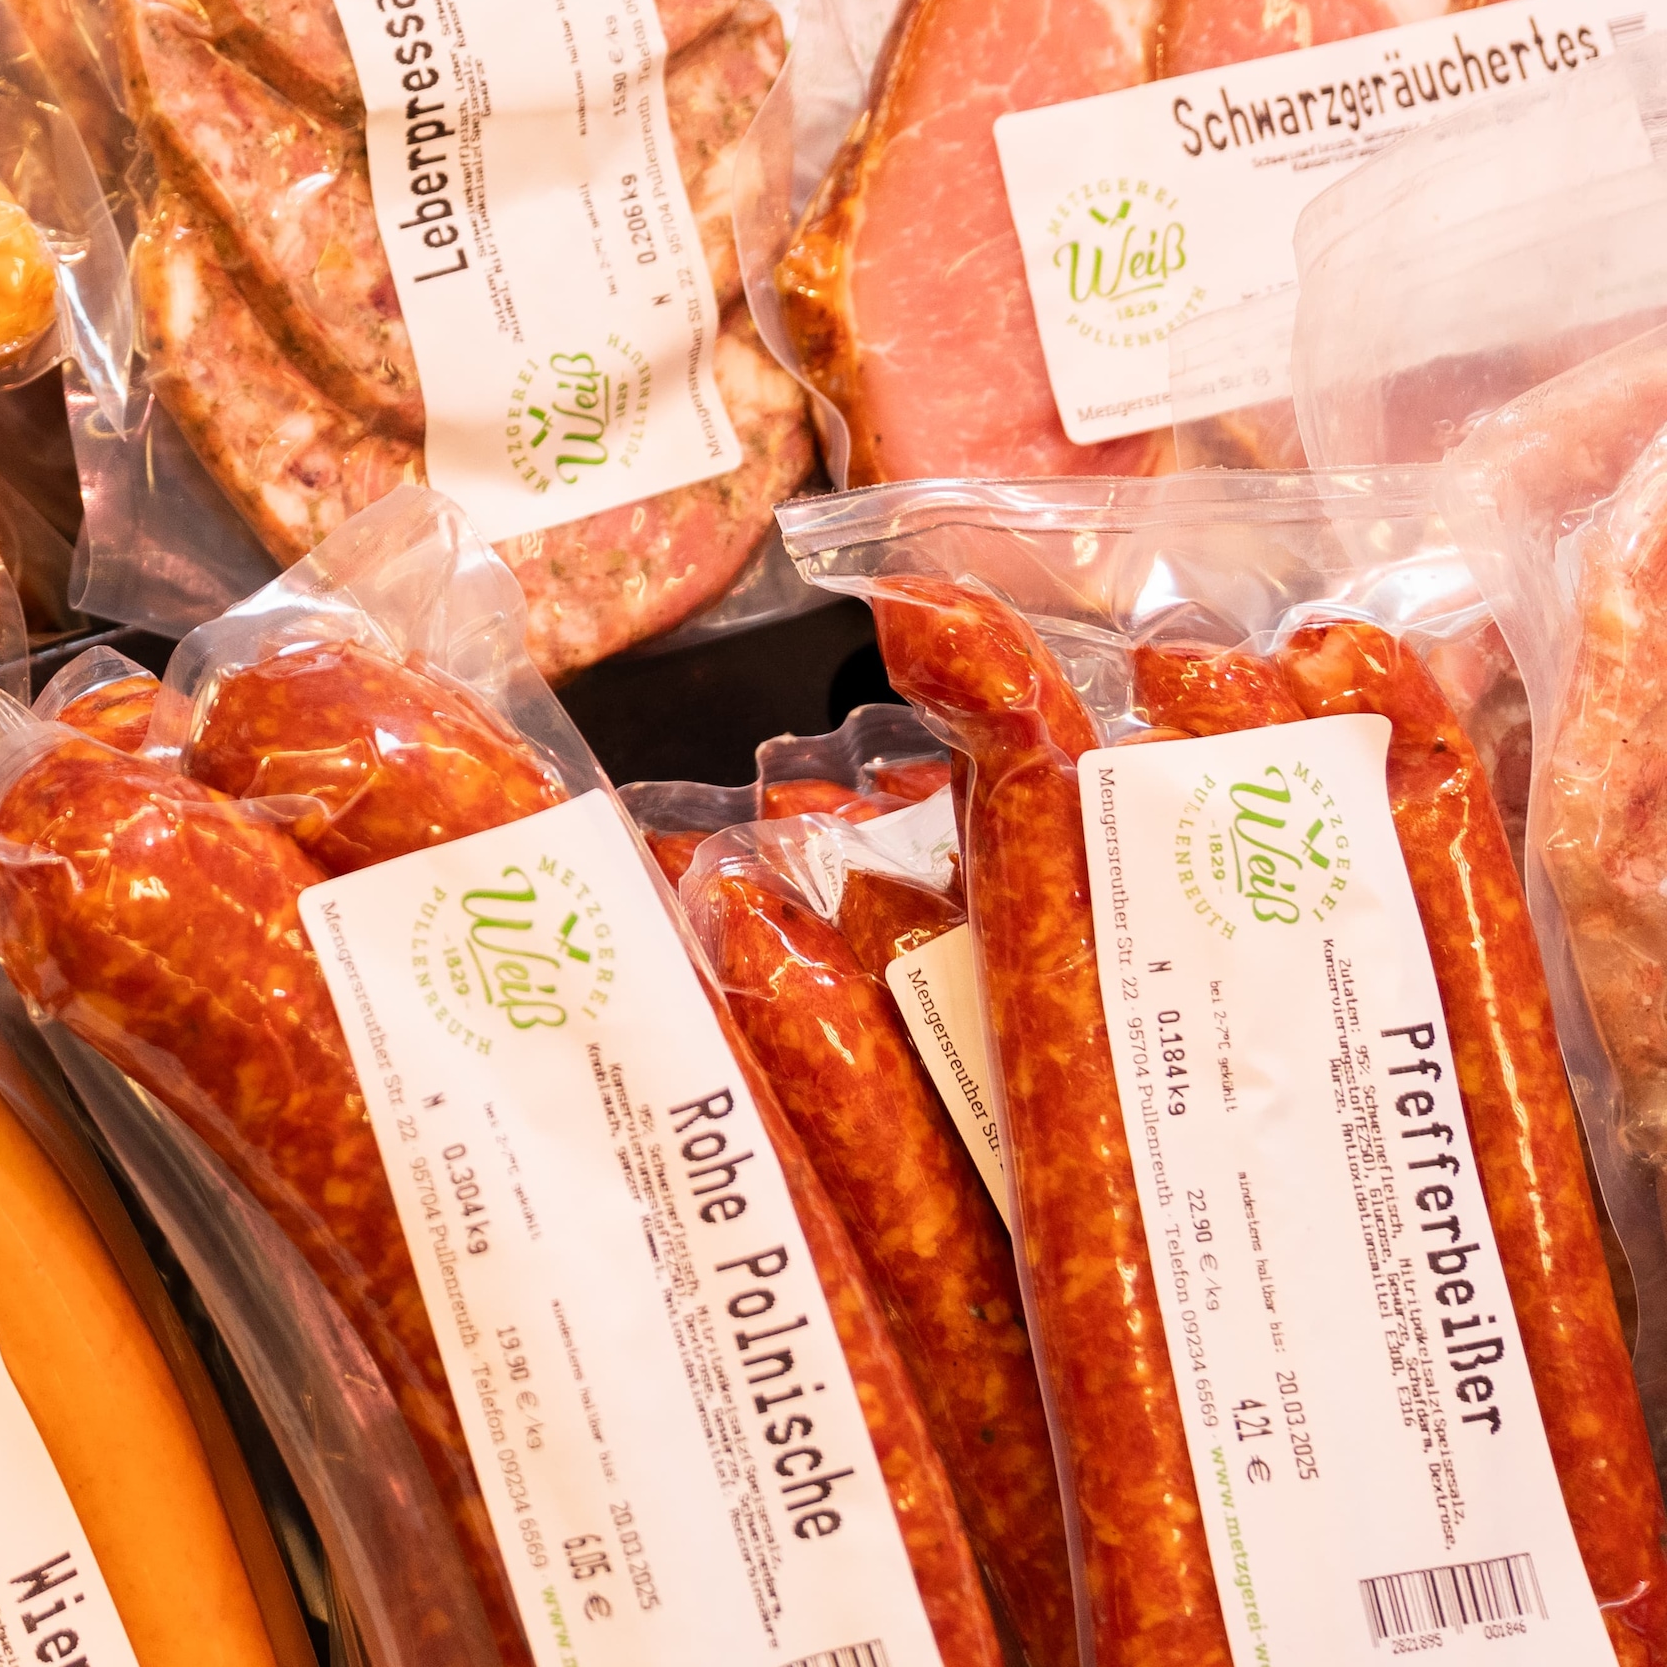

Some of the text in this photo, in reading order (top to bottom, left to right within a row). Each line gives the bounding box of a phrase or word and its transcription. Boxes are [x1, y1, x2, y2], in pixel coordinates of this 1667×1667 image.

[1172, 17, 1599, 157] Schwarzgeräuchertes
[1052, 222, 1187, 302] Weiß
[549, 351, 610, 485] Weiß
[1173, 773, 1237, 941] PULLENREUTH
[1207, 833, 1226, 882] 1829
[1228, 765, 1303, 925] Weiß
[1293, 762, 1350, 922] METZGEREI
[460, 865, 567, 1031] Weiß
[906, 967, 989, 1120] Mengersreuther
[1126, 1016, 1219, 1428] 95704 Pullenreuth Telefon 09234 6569
[1379, 1021, 1505, 1436] Pfefferbeißer
[668, 1087, 855, 1540] Rohe Polnische
[1231, 1398, 1272, 1442] 4.21
[1274, 1370, 1319, 1481] 20.03.2025
[562, 1534, 612, 1581] 6.05
[608, 1500, 660, 1611] 20.03.2025
